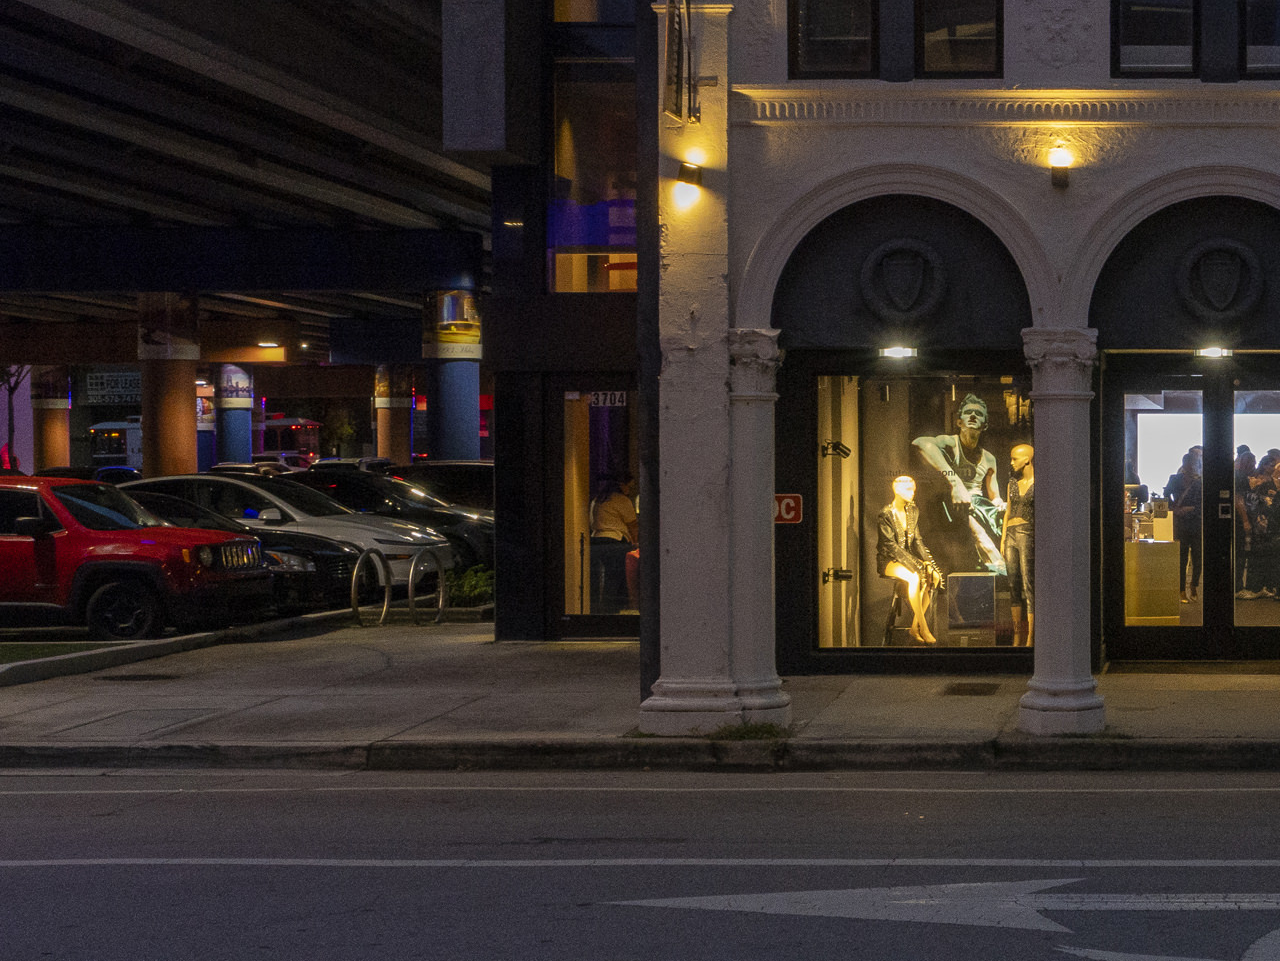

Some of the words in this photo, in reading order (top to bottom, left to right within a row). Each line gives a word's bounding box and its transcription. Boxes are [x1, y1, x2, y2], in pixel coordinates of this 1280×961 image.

[106, 378, 119, 389] FOR
[121, 378, 141, 389] LEASE
[592, 392, 625, 406] 3704
